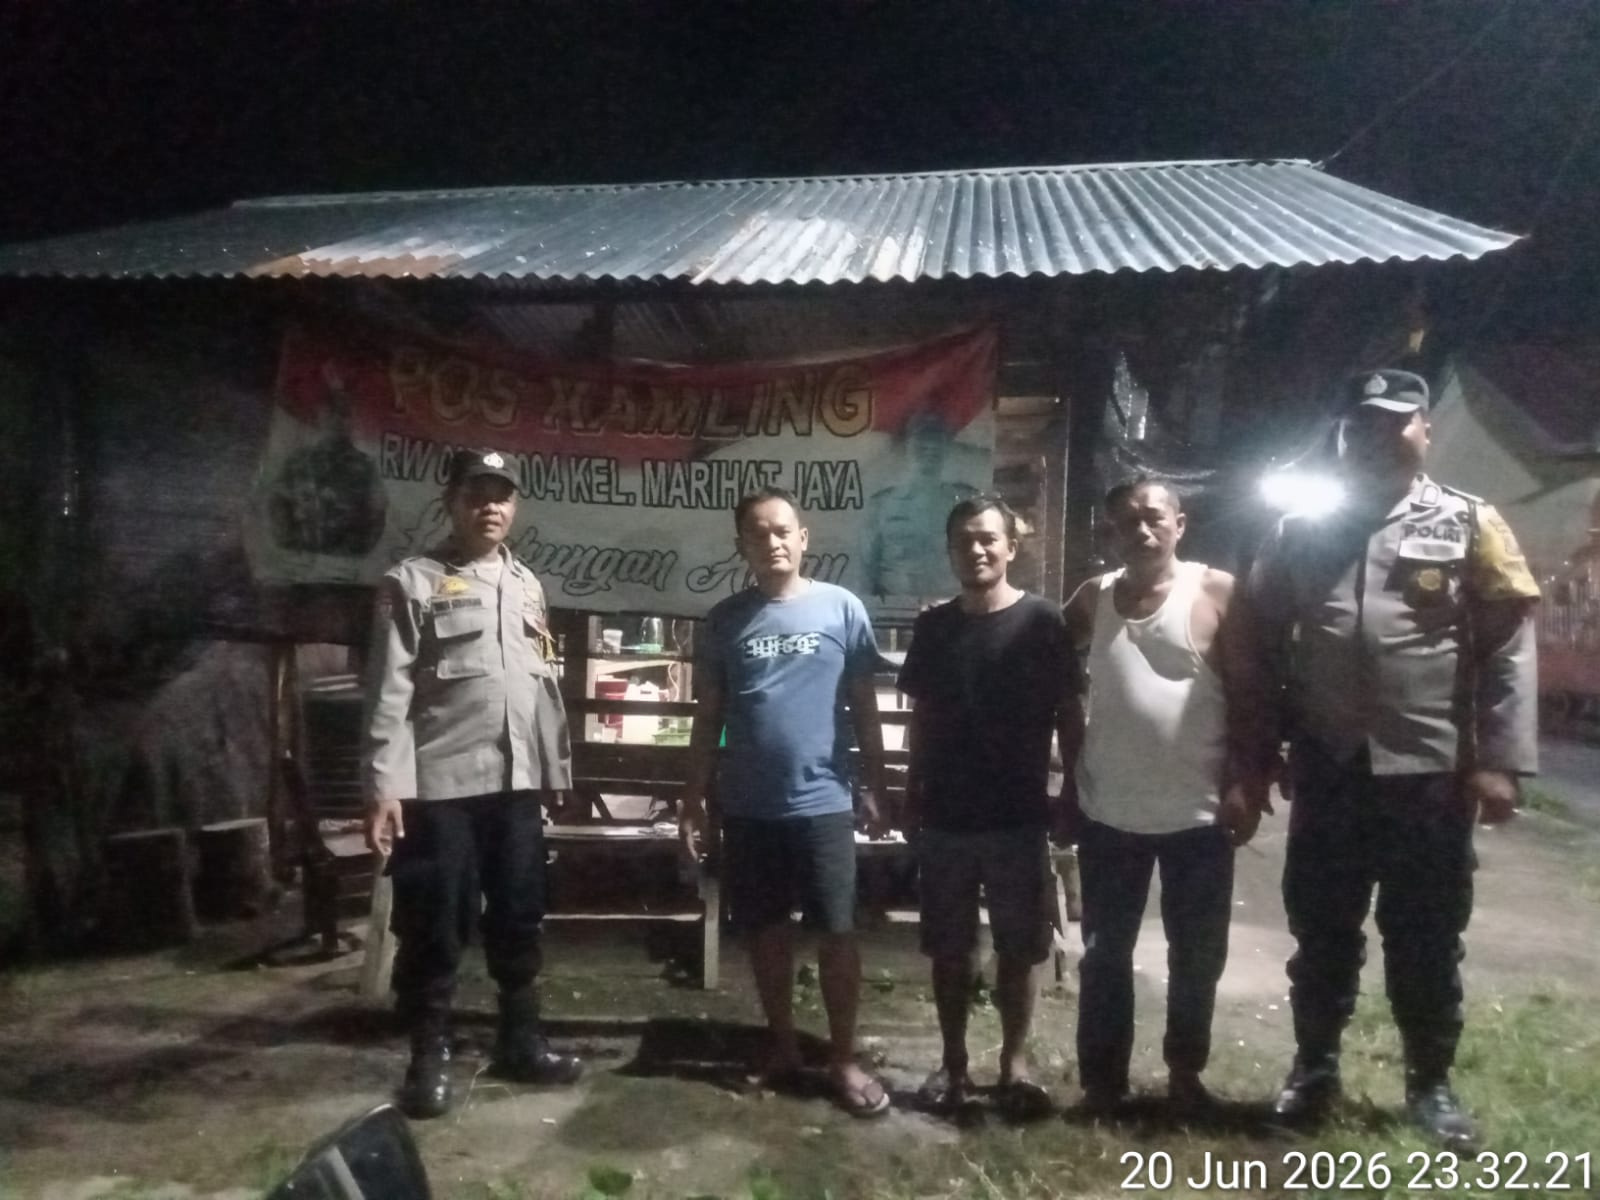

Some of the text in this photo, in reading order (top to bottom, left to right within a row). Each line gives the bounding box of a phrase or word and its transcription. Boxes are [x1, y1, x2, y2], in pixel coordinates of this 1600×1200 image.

[391, 350, 873, 439] POS KAMLING
[382, 432, 433, 483] RW
[569, 456, 636, 506] KEL.
[642, 459, 783, 510] MARIHAT
[793, 460, 864, 510] JAYA
